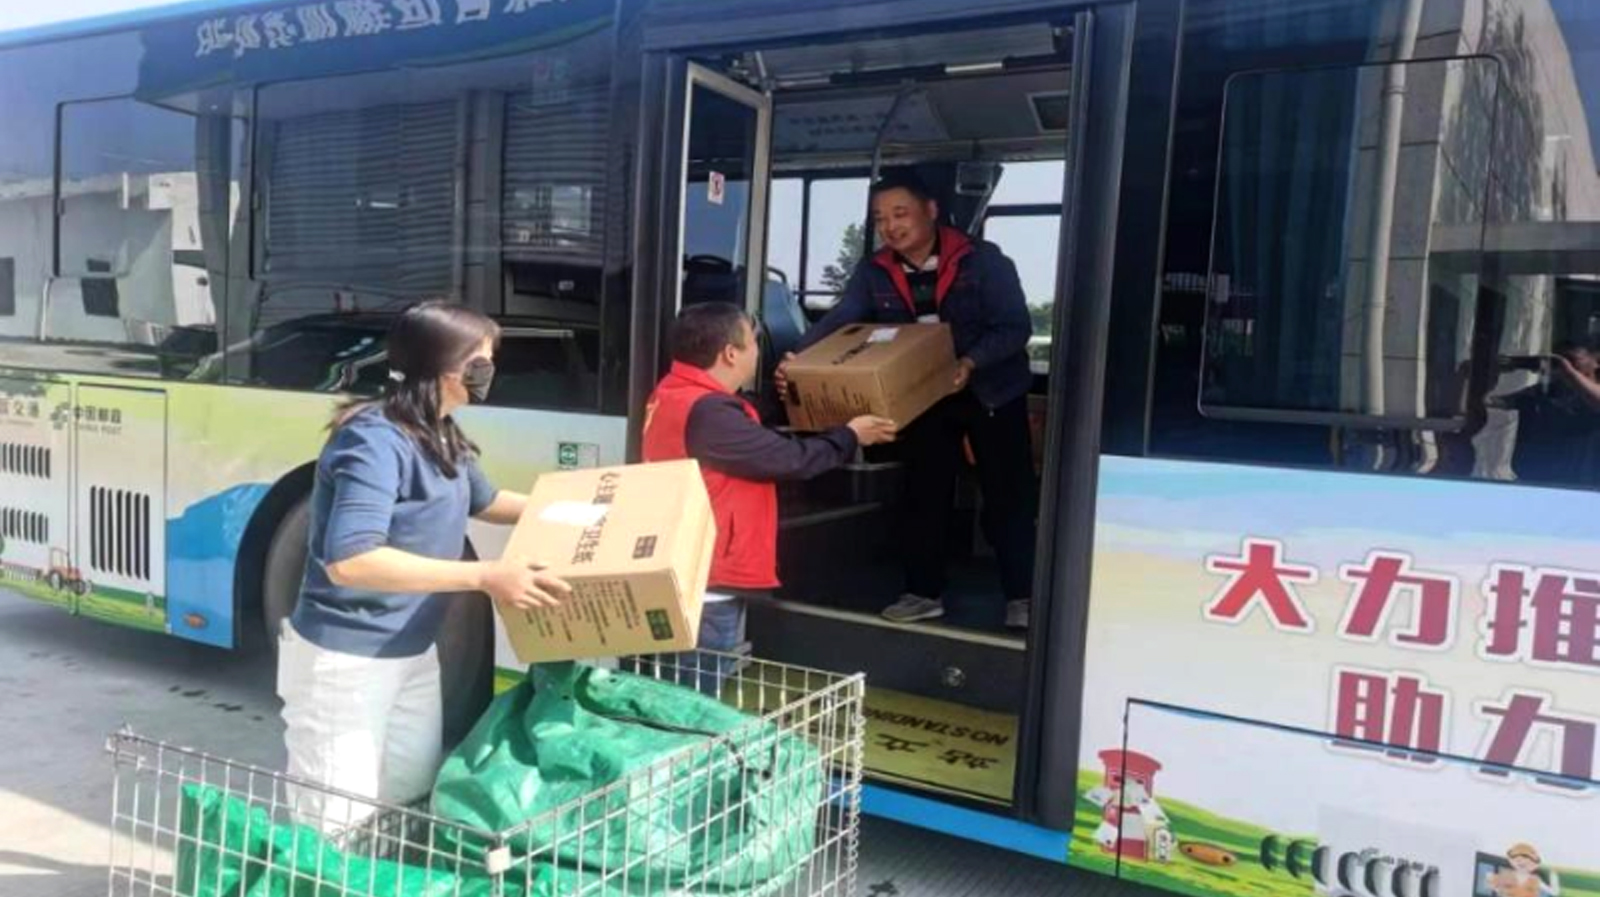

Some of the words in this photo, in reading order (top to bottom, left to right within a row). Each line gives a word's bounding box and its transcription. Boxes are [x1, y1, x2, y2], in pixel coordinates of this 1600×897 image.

[1206, 541, 1600, 667] 大力推
[969, 730, 1009, 746] NO
[1330, 669, 1598, 791] 助力
